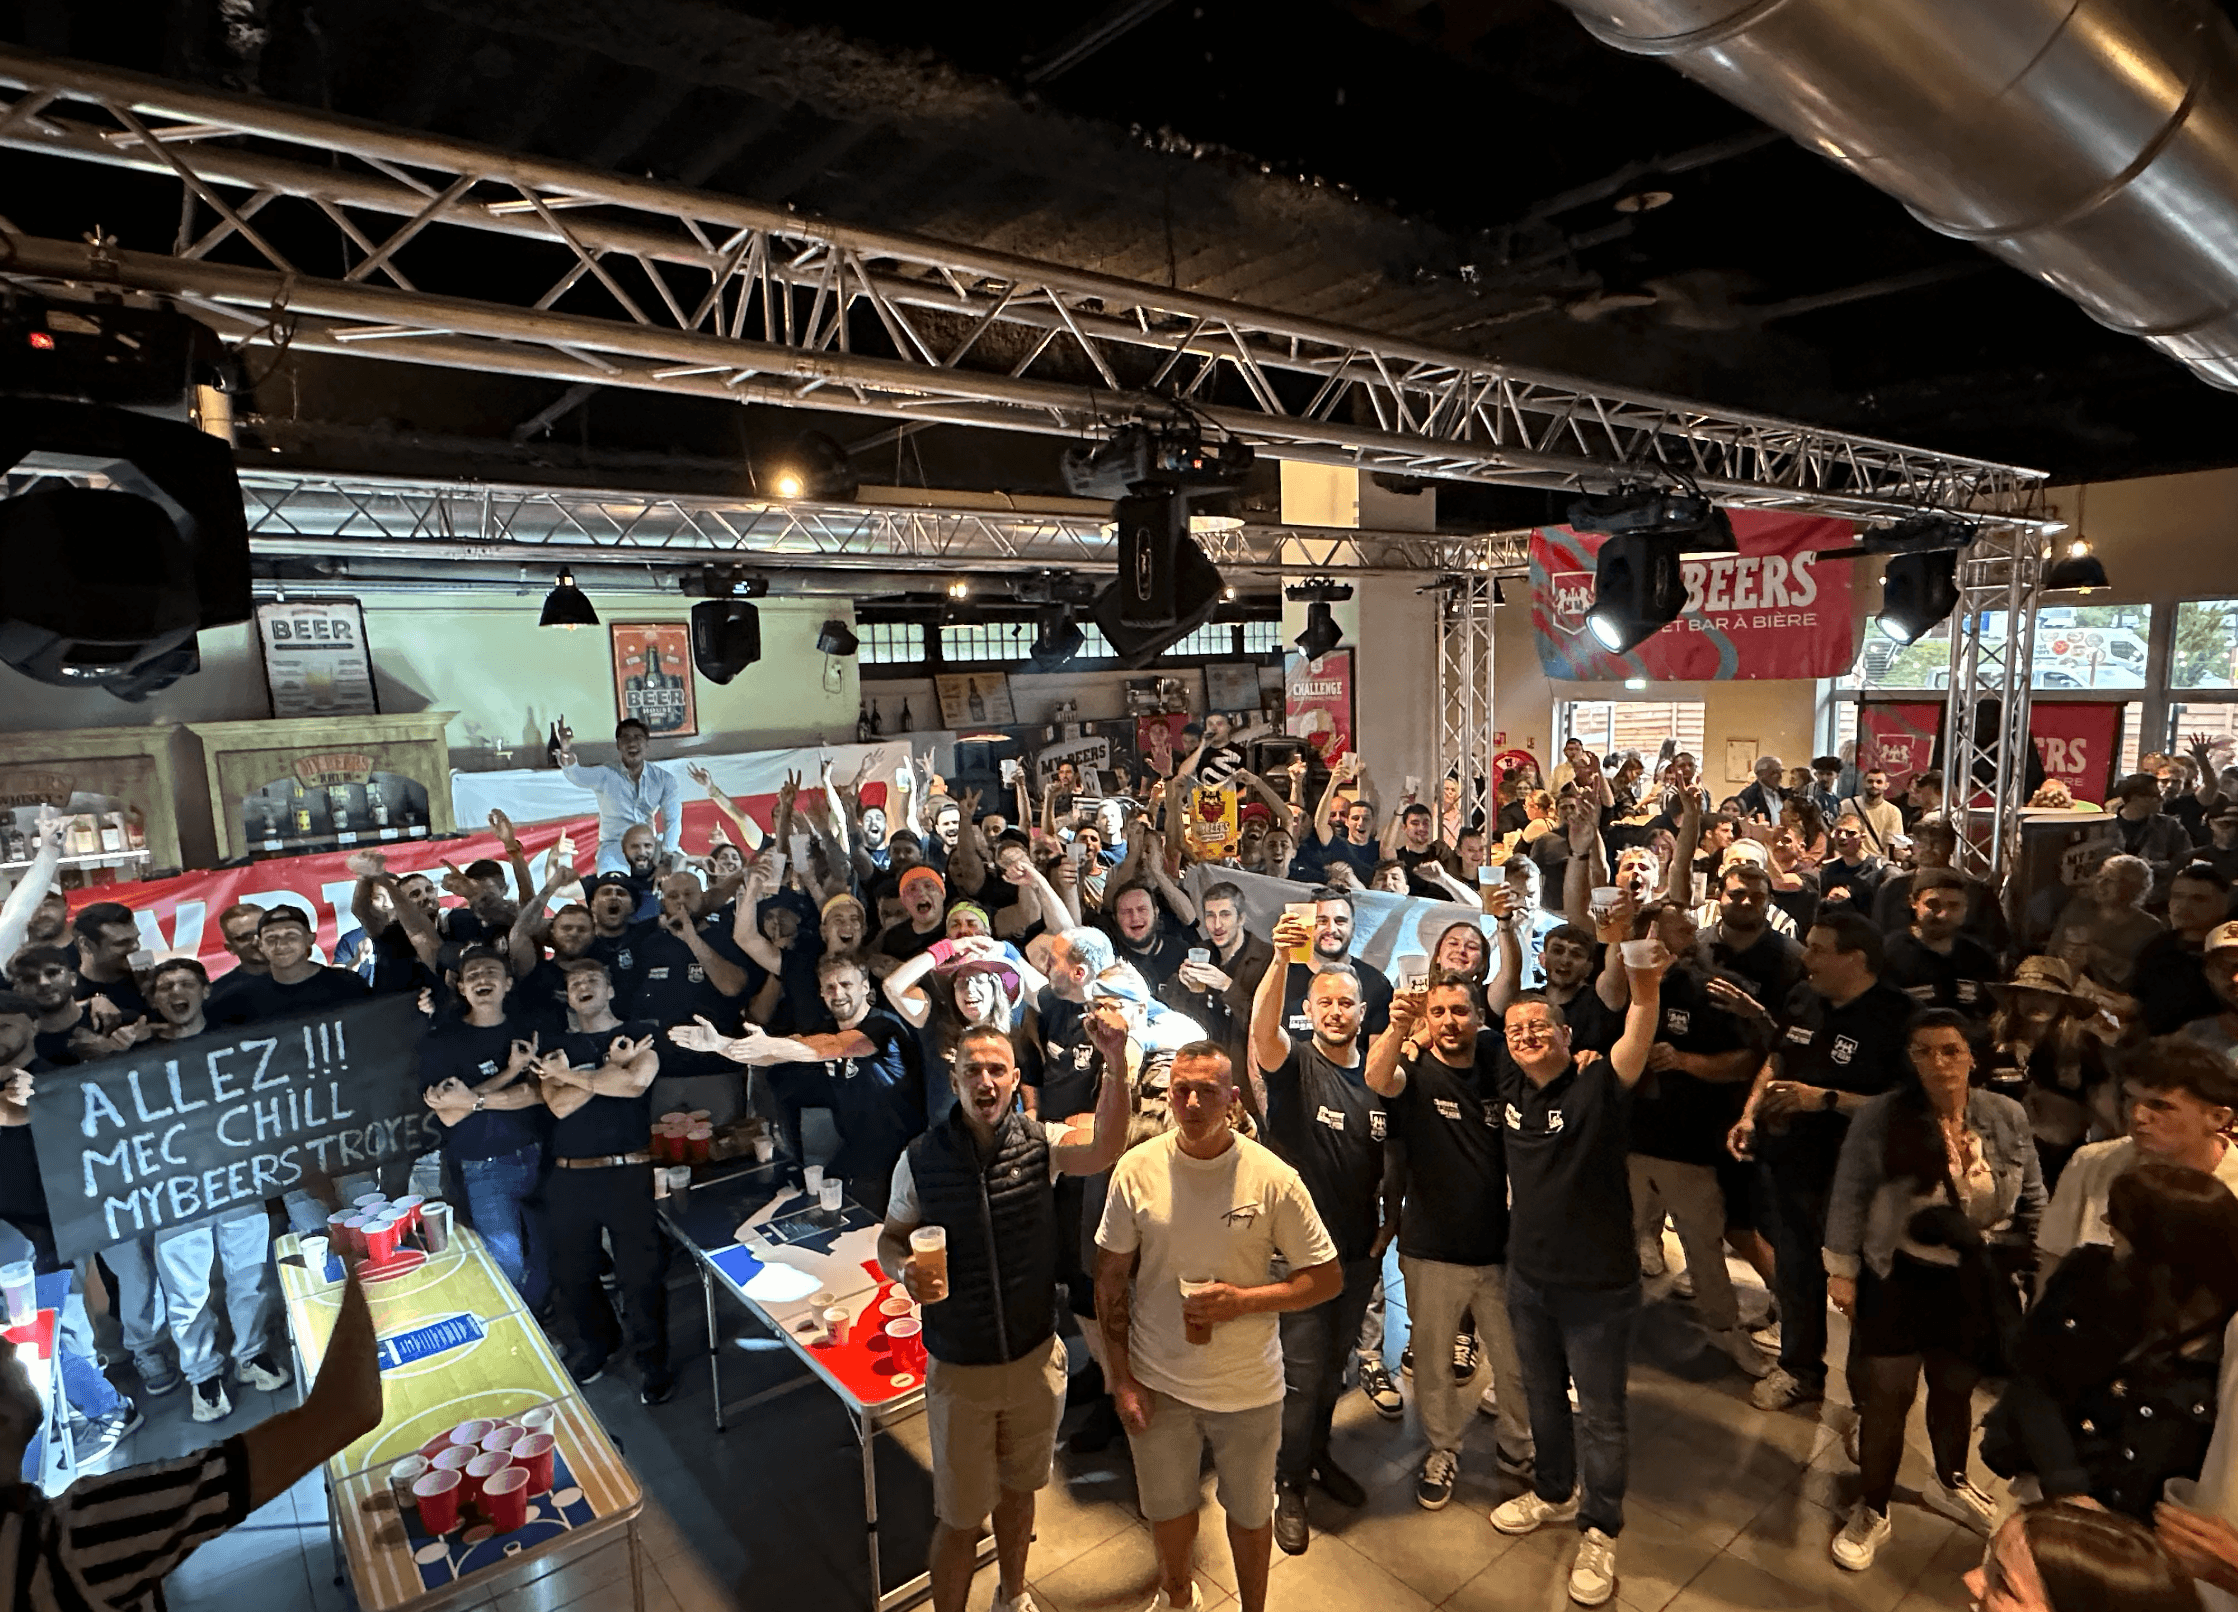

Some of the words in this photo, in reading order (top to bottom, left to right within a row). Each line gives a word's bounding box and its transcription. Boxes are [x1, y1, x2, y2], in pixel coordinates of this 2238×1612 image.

[1680, 551, 1817, 613] BEERS
[271, 619, 353, 639] BEER
[1689, 617, 1728, 631] BAR
[1733, 613, 1748, 629] À
[1753, 612, 1817, 628] BIÈRE
[626, 688, 685, 708] BEER
[1293, 681, 1342, 696] CHALLENGE
[81, 1038, 289, 1137] ALLEZ
[82, 1123, 187, 1198] MEC
